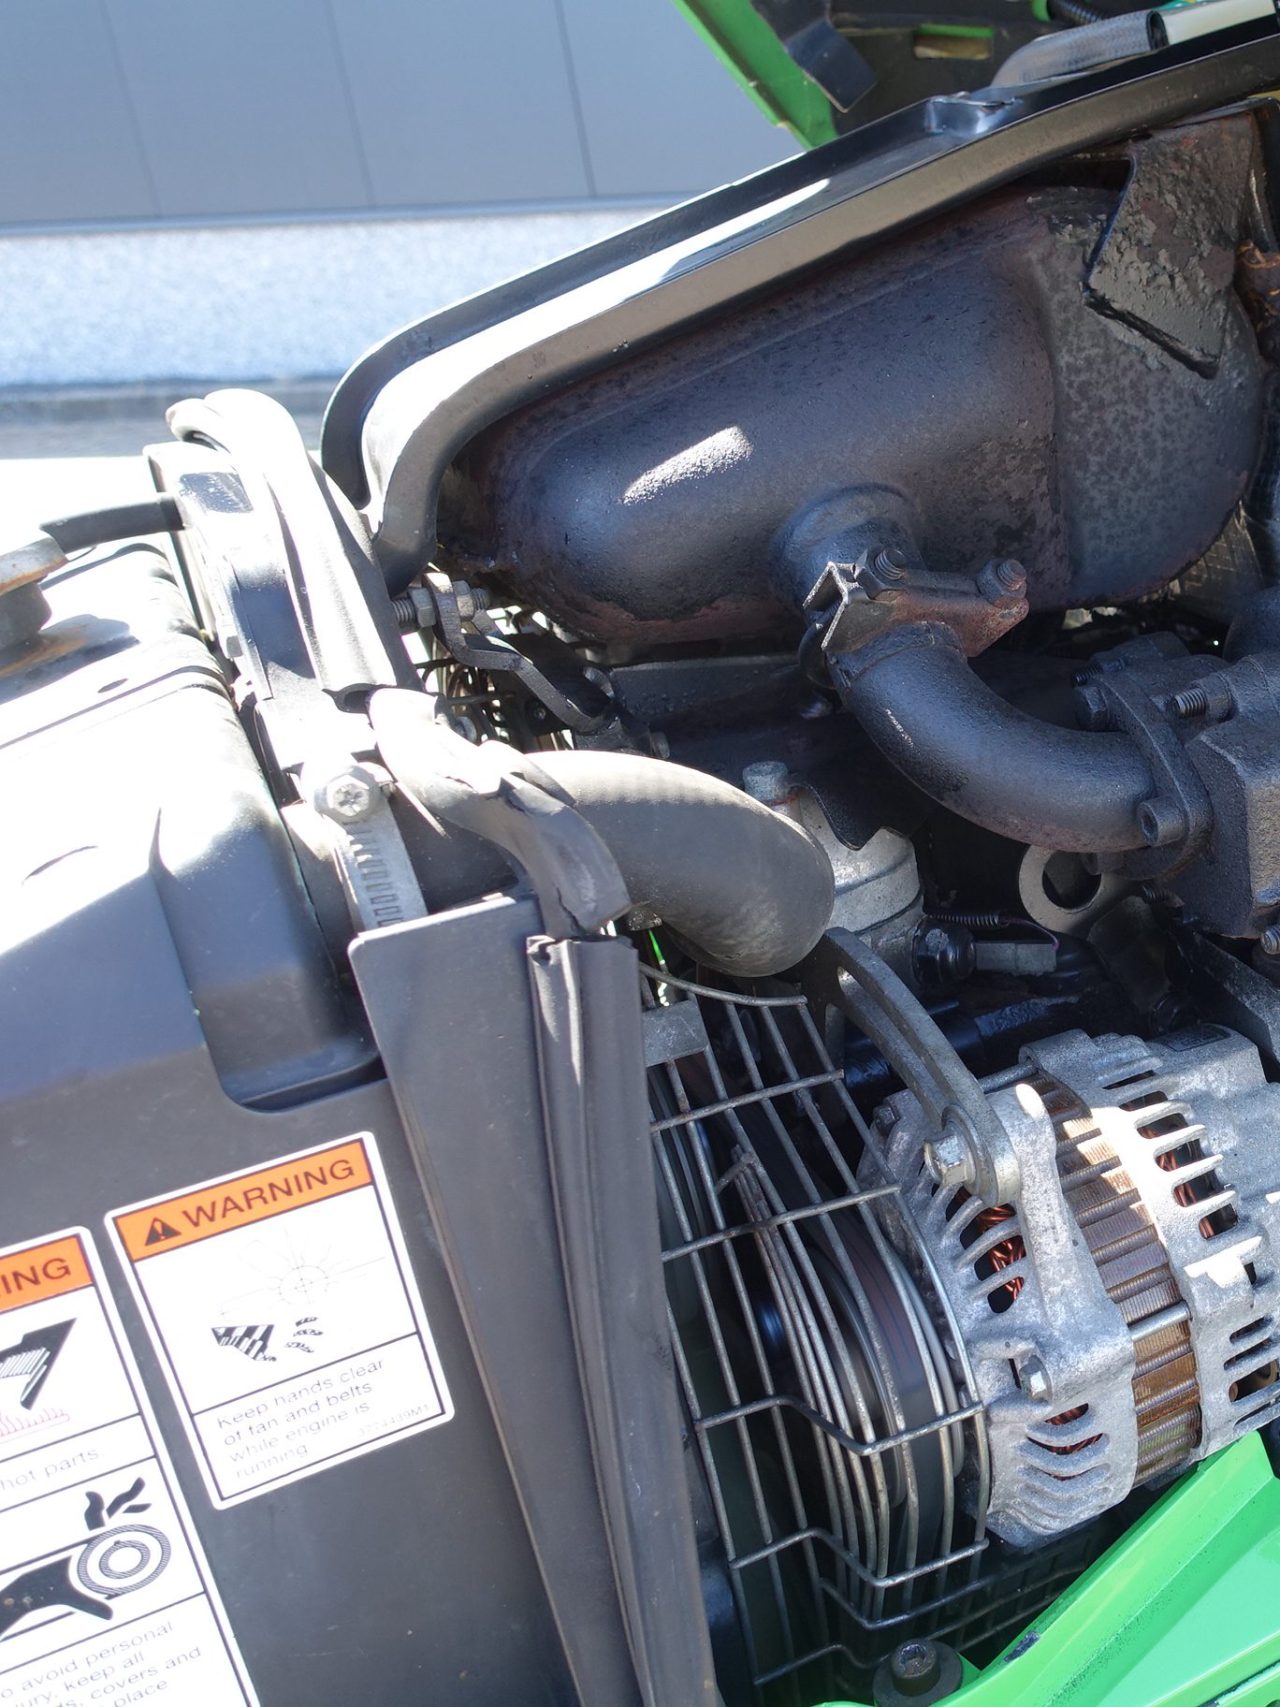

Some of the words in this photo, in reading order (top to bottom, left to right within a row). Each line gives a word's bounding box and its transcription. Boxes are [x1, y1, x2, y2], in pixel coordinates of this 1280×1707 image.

[182, 1159, 355, 1228] WARNING
[0, 1257, 71, 1295] ING
[217, 1403, 269, 1430] Keep
[274, 1378, 334, 1407] hands
[340, 1358, 385, 1384] clear
[224, 1430, 242, 1446] of
[249, 1419, 278, 1437] fan
[285, 1400, 321, 1423] and
[327, 1382, 373, 1407] belts
[229, 1436, 280, 1463] while
[286, 1409, 349, 1441] engine
[235, 1443, 308, 1480] running
[0, 1470, 36, 1490] hot
[22, 1658, 79, 1691] avoid
[85, 1621, 174, 1668] personal
[64, 1664, 115, 1691] keep
[123, 1651, 145, 1669] all
[90, 1667, 159, 1700] covers
[165, 1645, 202, 1670] and
[113, 1680, 168, 1707] place
